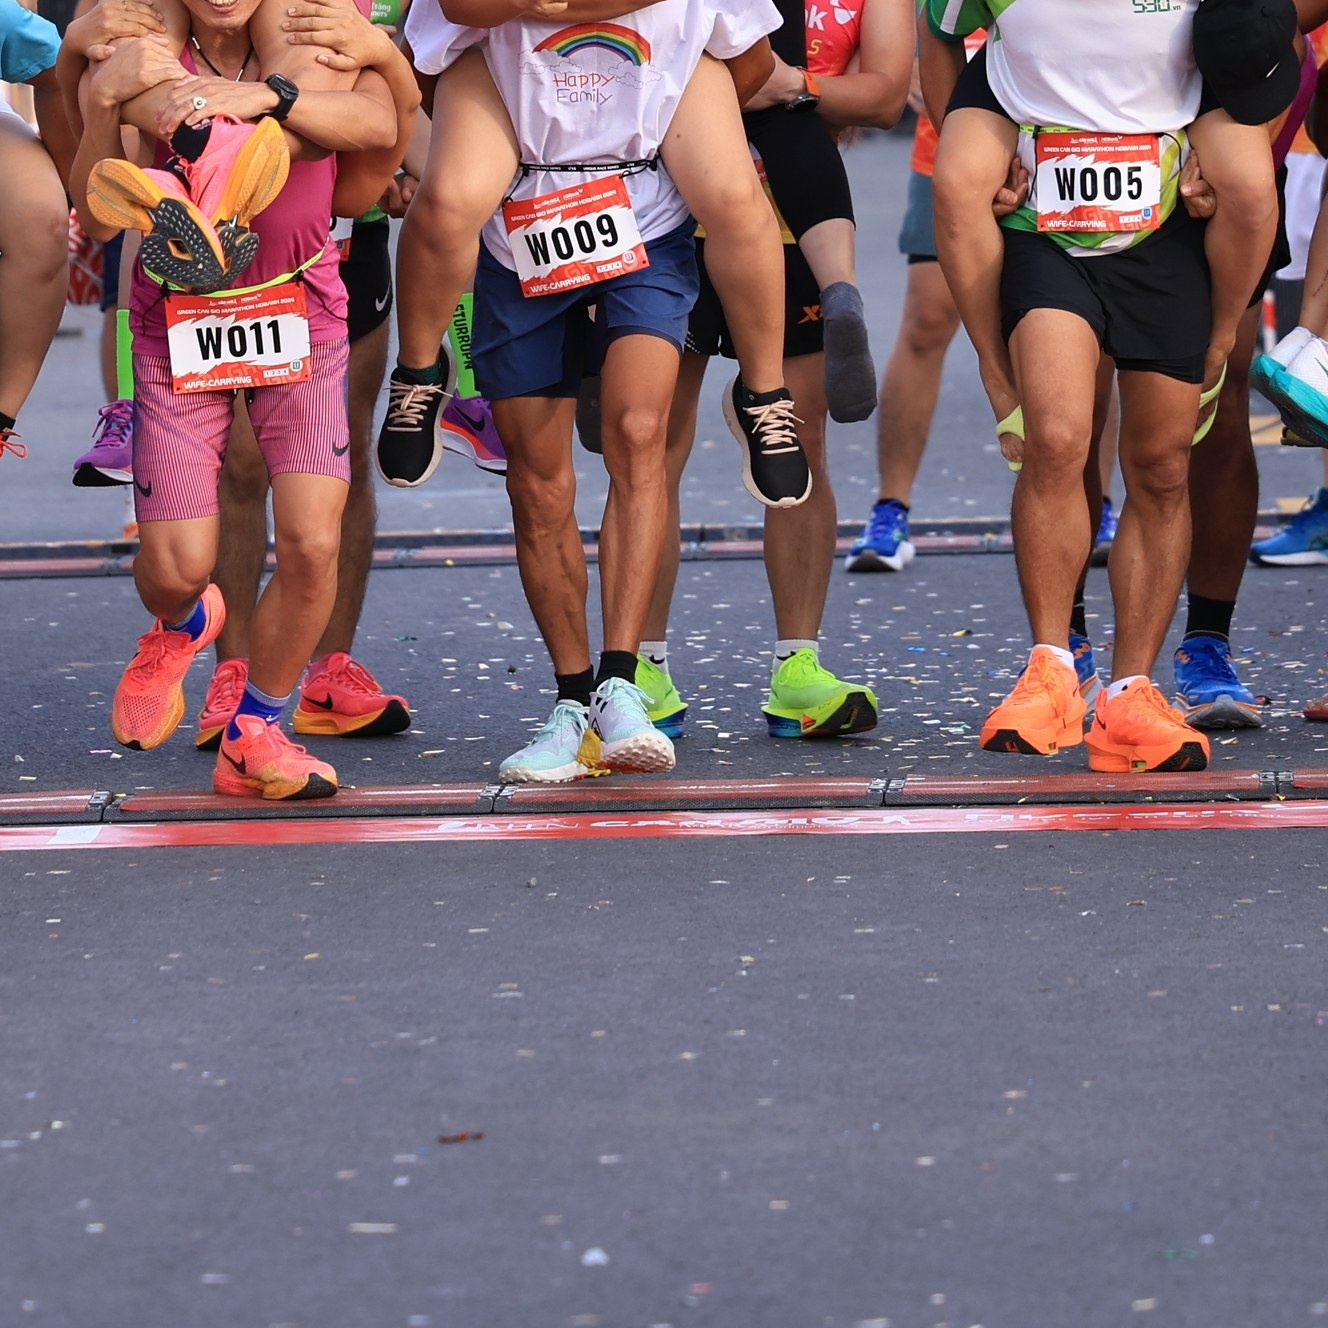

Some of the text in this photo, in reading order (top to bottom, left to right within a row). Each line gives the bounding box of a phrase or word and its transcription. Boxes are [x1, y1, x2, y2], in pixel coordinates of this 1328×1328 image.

[553, 73, 615, 88] Happy
[556, 88, 613, 105] Family
[1054, 166, 1142, 201] W005
[1047, 220, 1106, 228] WIFE-CARRYING
[524, 214, 618, 266] W009
[530, 274, 590, 293] WIFE-CARRYING
[221, 305, 254, 313] MARATHON
[196, 320, 281, 360] W011
[184, 376, 252, 389] WIFE-CARRYING
